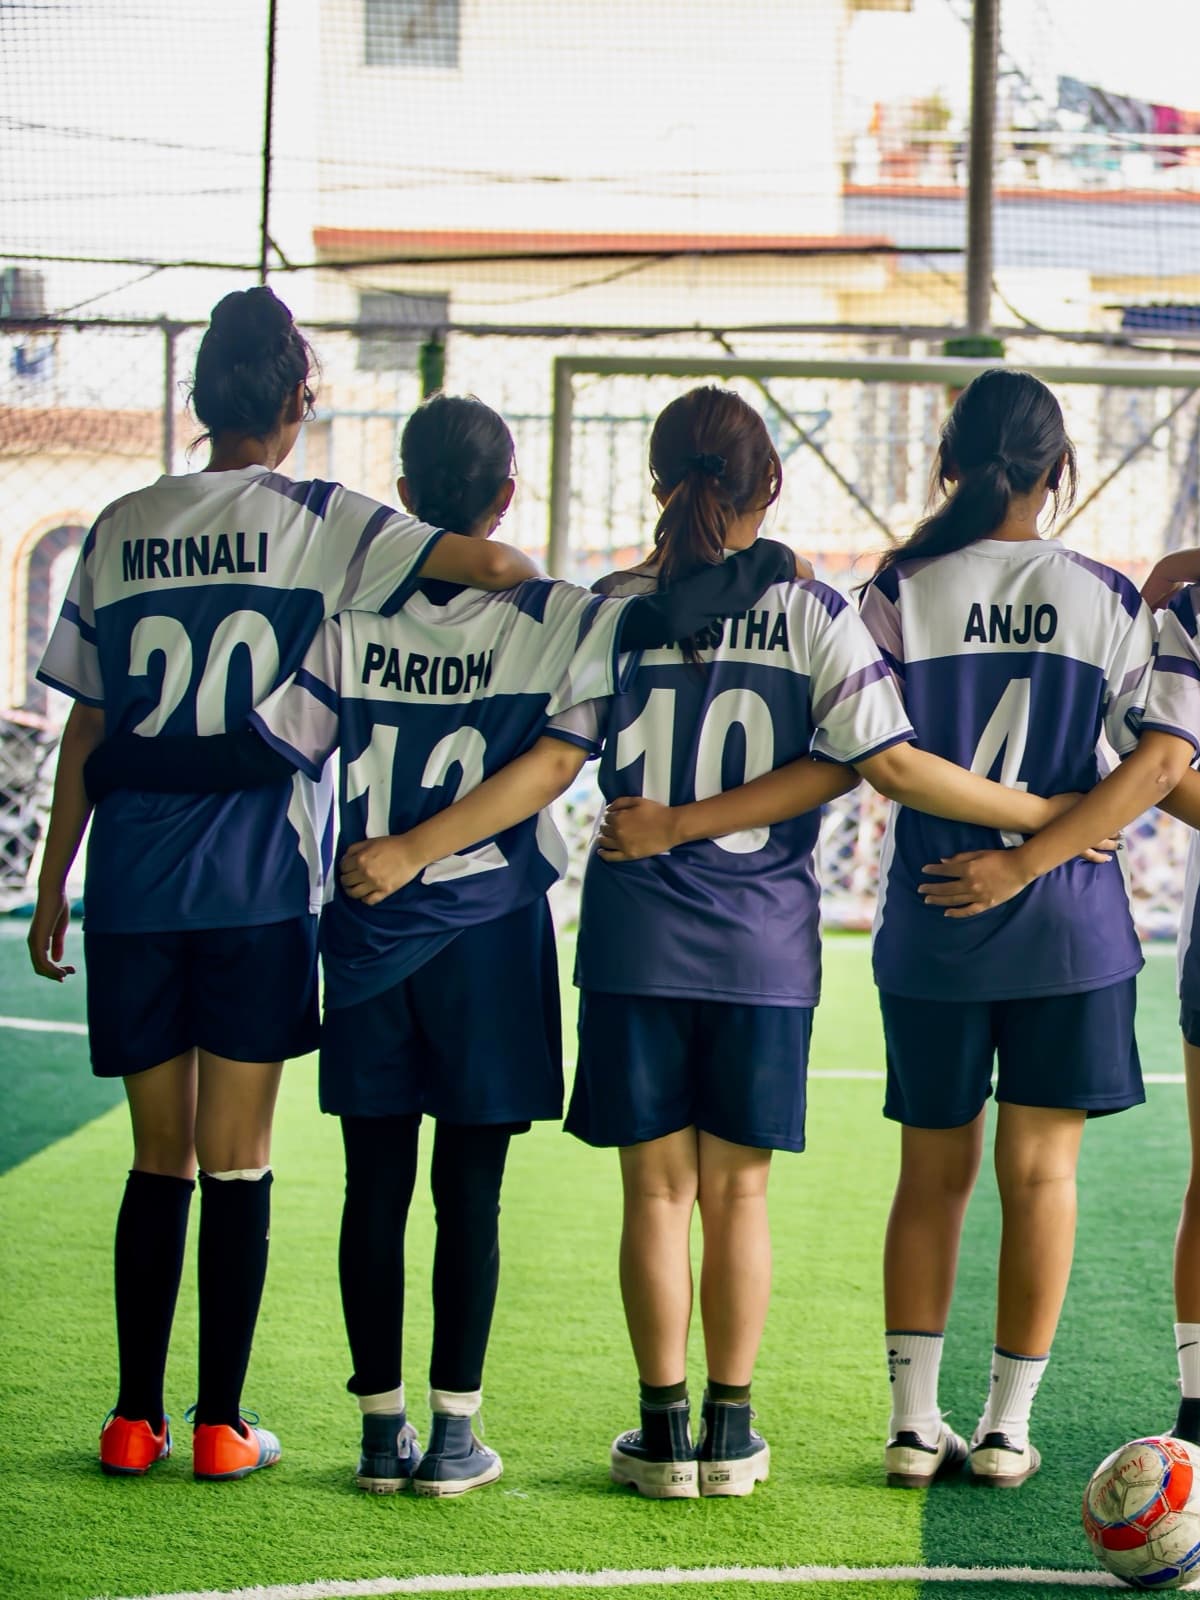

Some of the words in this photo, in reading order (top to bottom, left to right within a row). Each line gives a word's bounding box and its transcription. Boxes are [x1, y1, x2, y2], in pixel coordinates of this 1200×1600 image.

[122, 532, 268, 581] MRINALI
[964, 603, 1058, 644] ANJO
[128, 610, 280, 736] 20
[346, 724, 509, 885] 12
[616, 688, 776, 855] 10
[970, 678, 1031, 849] 4
